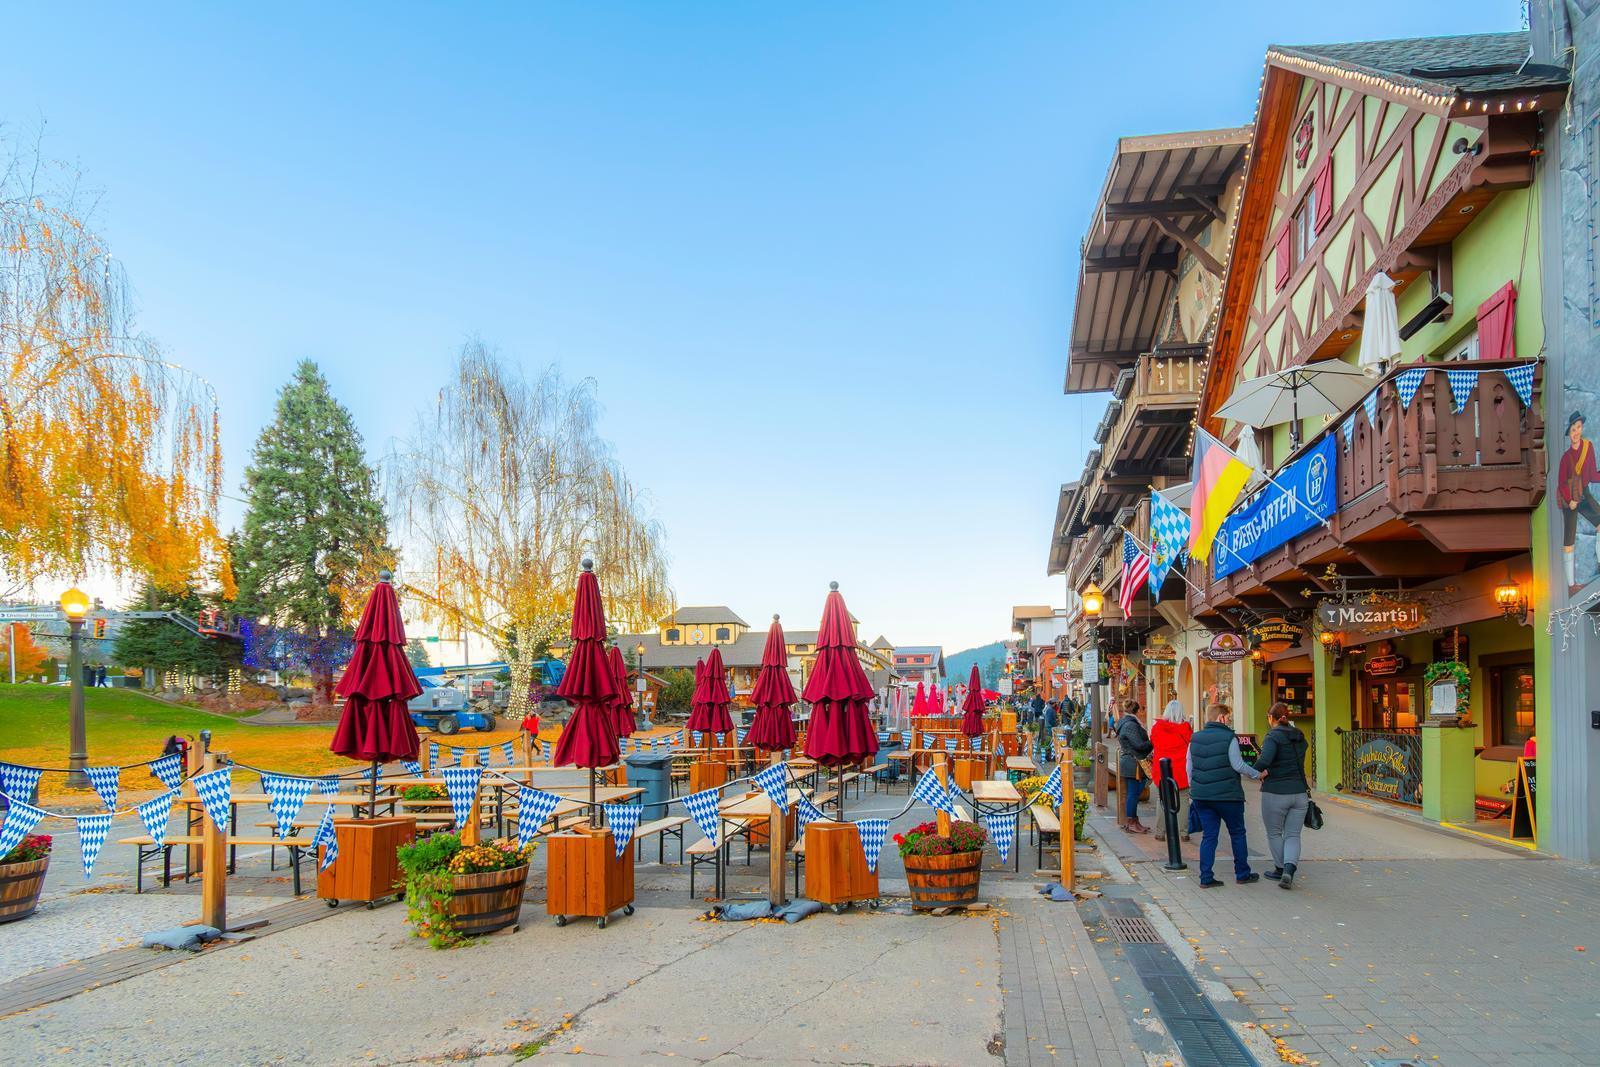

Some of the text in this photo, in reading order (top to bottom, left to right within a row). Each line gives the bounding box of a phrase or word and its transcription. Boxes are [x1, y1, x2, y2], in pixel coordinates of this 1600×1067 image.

[1232, 485, 1298, 552] BIERGARTEN
[1338, 607, 1408, 626] Mozart's
[1252, 624, 1281, 635] Andreas
[1210, 649, 1246, 657] Gingerbread
[1356, 745, 1409, 776] Andreas Keller
[1361, 772, 1399, 794] Restaurant
